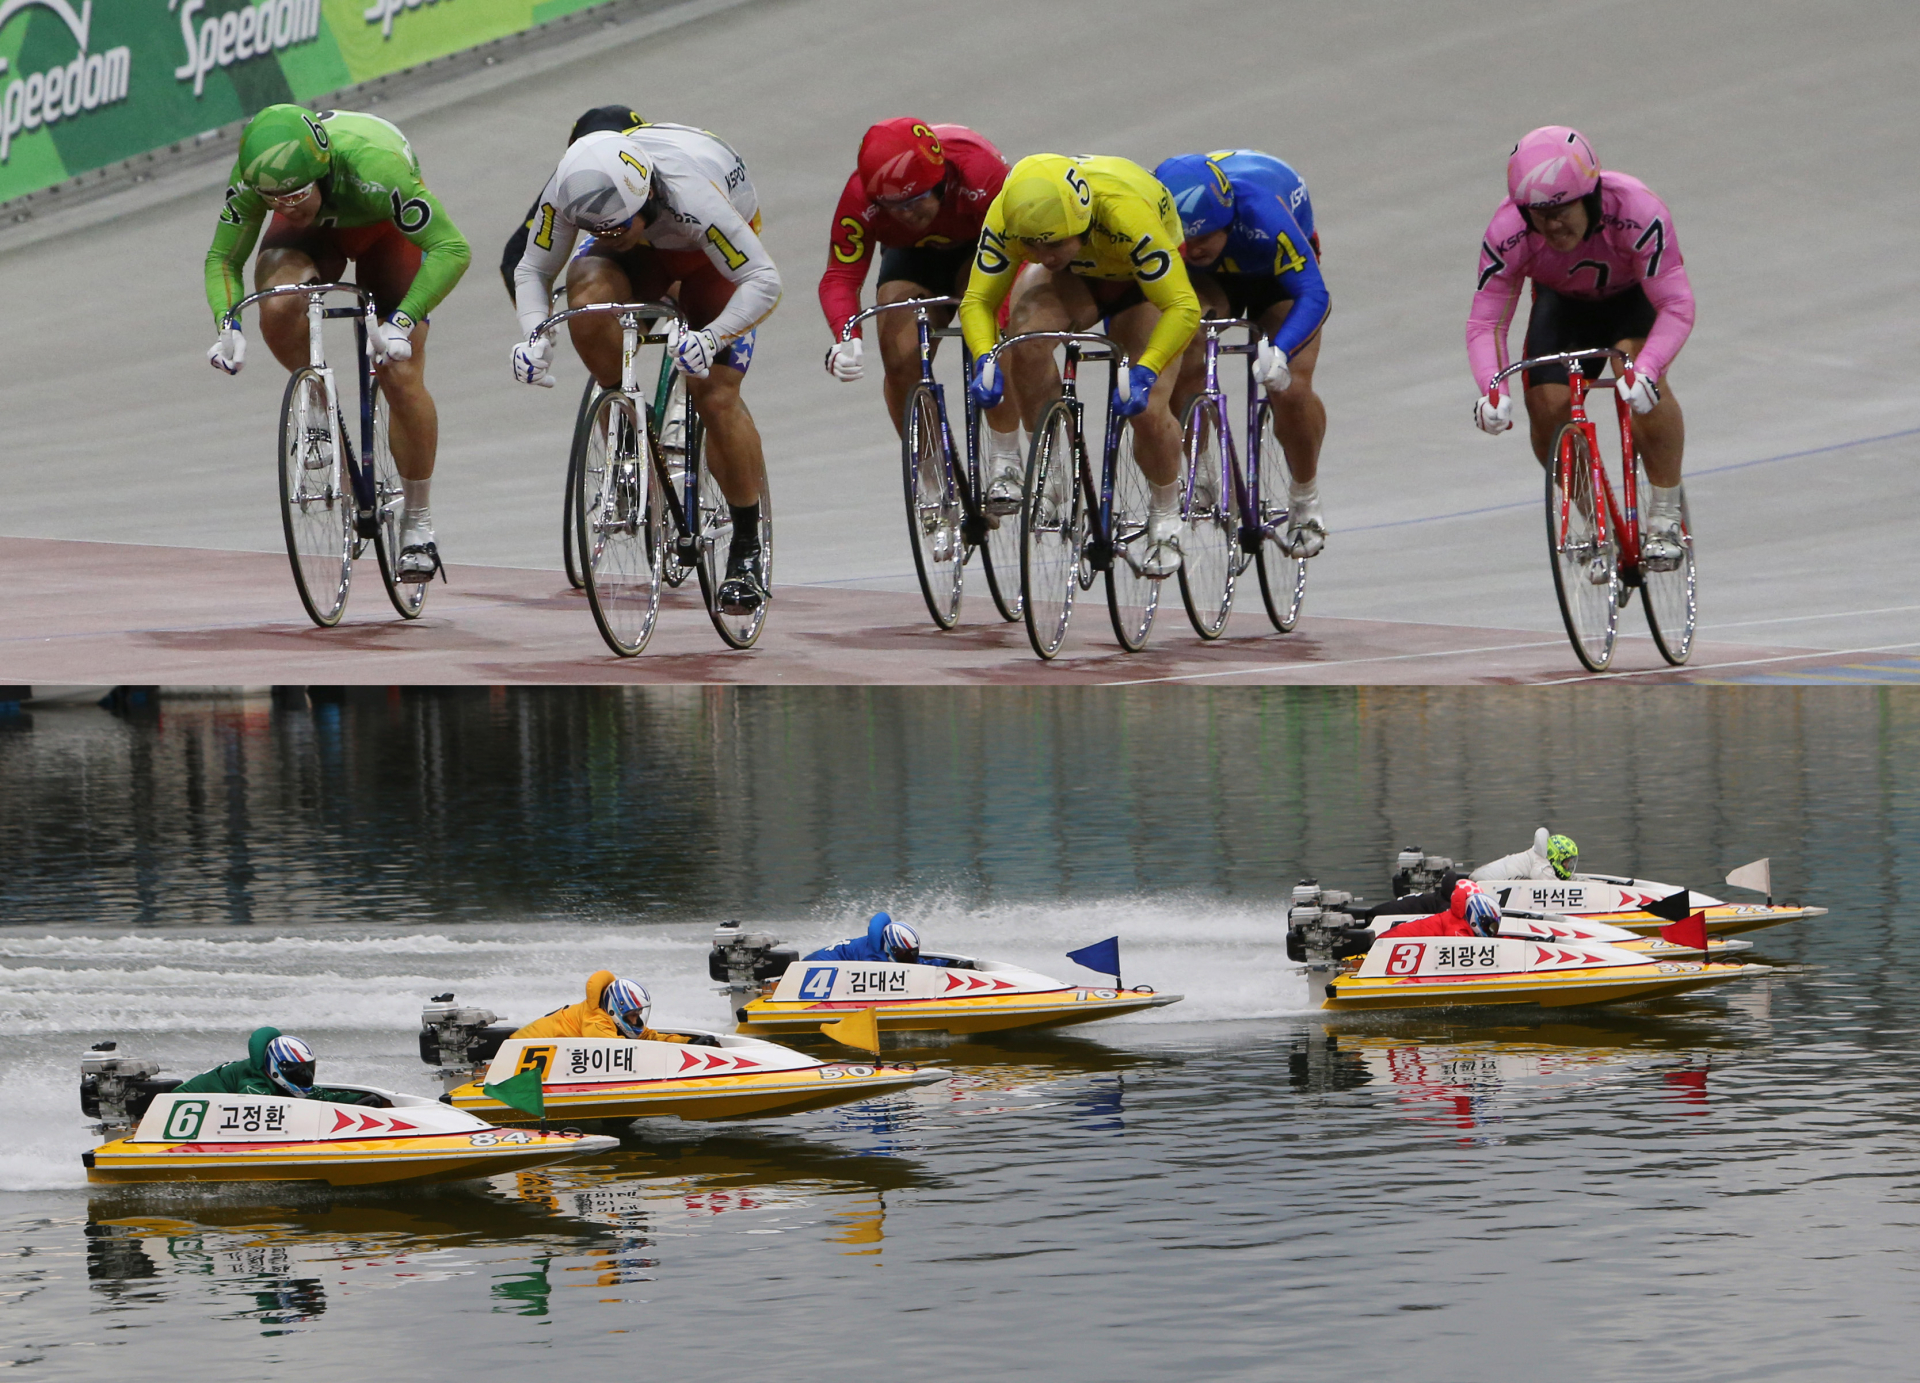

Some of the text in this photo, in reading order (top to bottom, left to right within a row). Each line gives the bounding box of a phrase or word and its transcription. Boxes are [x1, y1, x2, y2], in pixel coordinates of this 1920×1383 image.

[0, 46, 130, 160] peedom
[912, 124, 942, 153] 3
[618, 150, 648, 180] 1
[1065, 167, 1092, 207] 5
[390, 186, 432, 235] 6
[534, 202, 557, 252] 1
[834, 216, 865, 264] 3
[705, 223, 748, 271] 1
[1129, 233, 1171, 282] 5
[1273, 230, 1307, 276] 4
[1633, 214, 1666, 279] 7
[1496, 887, 1584, 908] 1 박석문
[1729, 904, 1774, 915] 28
[1391, 944, 1496, 974] 3 최광성
[1653, 962, 1702, 973] 35
[803, 969, 906, 998] 4 김대선
[1065, 989, 1118, 1001] 76
[519, 1046, 634, 1078] 5 황이태
[818, 1065, 875, 1079] 50
[168, 1102, 286, 1138] 6 고정환
[469, 1131, 532, 1147] 84
